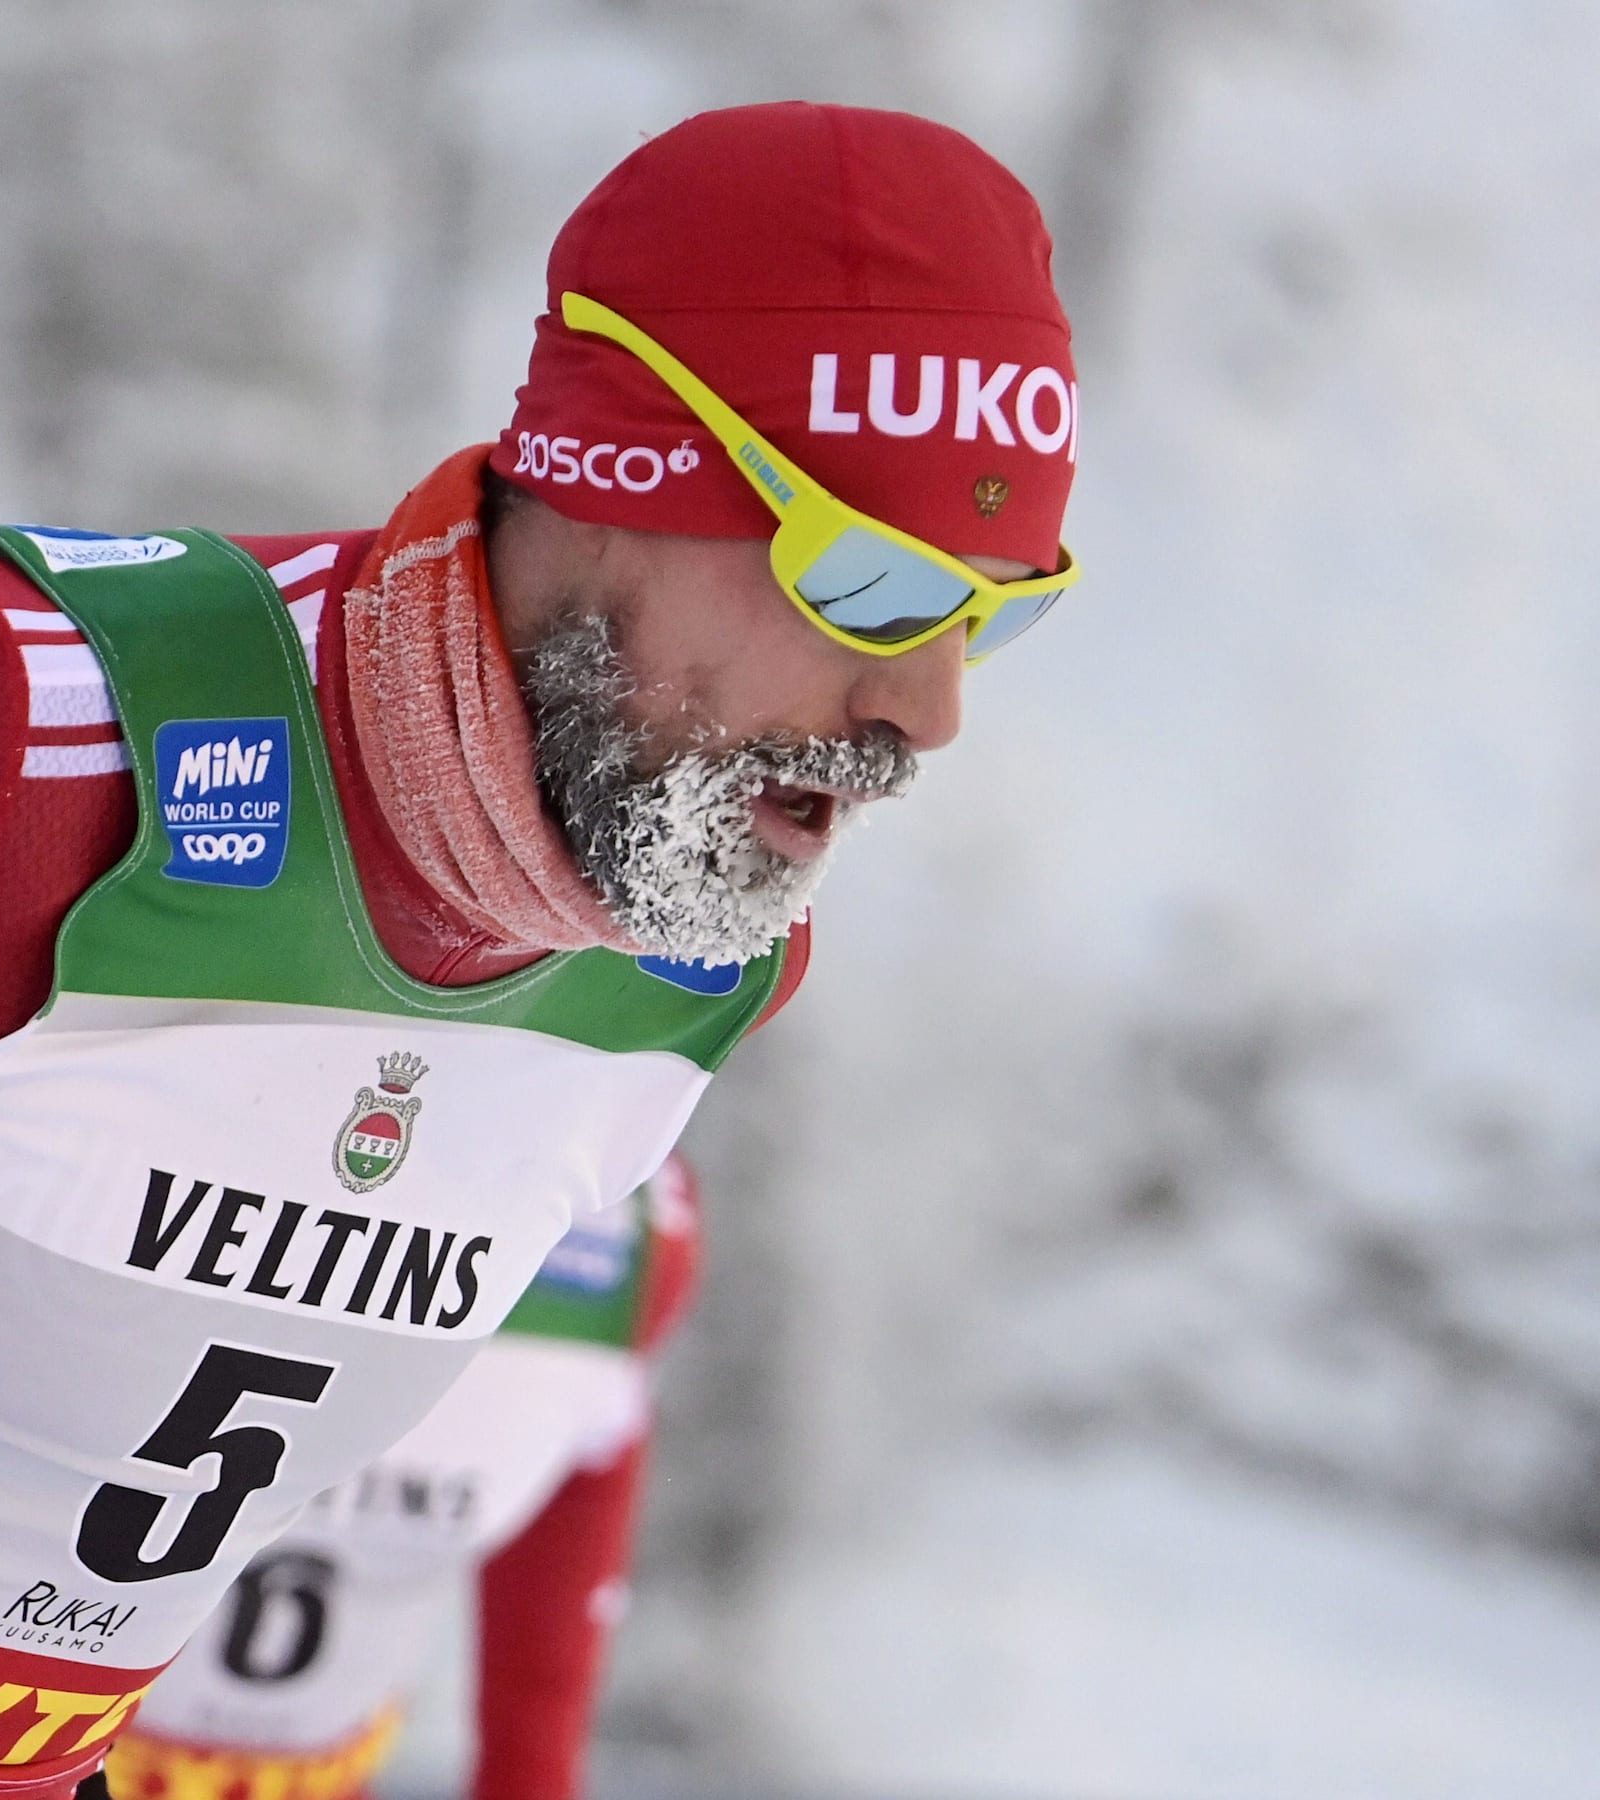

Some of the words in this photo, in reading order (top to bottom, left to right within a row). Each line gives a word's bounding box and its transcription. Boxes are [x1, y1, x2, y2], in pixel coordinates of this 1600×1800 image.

[164, 802, 234, 822] WORLD
[239, 801, 280, 821] CUP
[125, 1168, 493, 1329] VELTINS
[76, 1342, 336, 1583] 5
[3, 1580, 138, 1637] RUKA!
[222, 1546, 338, 1683] 6
